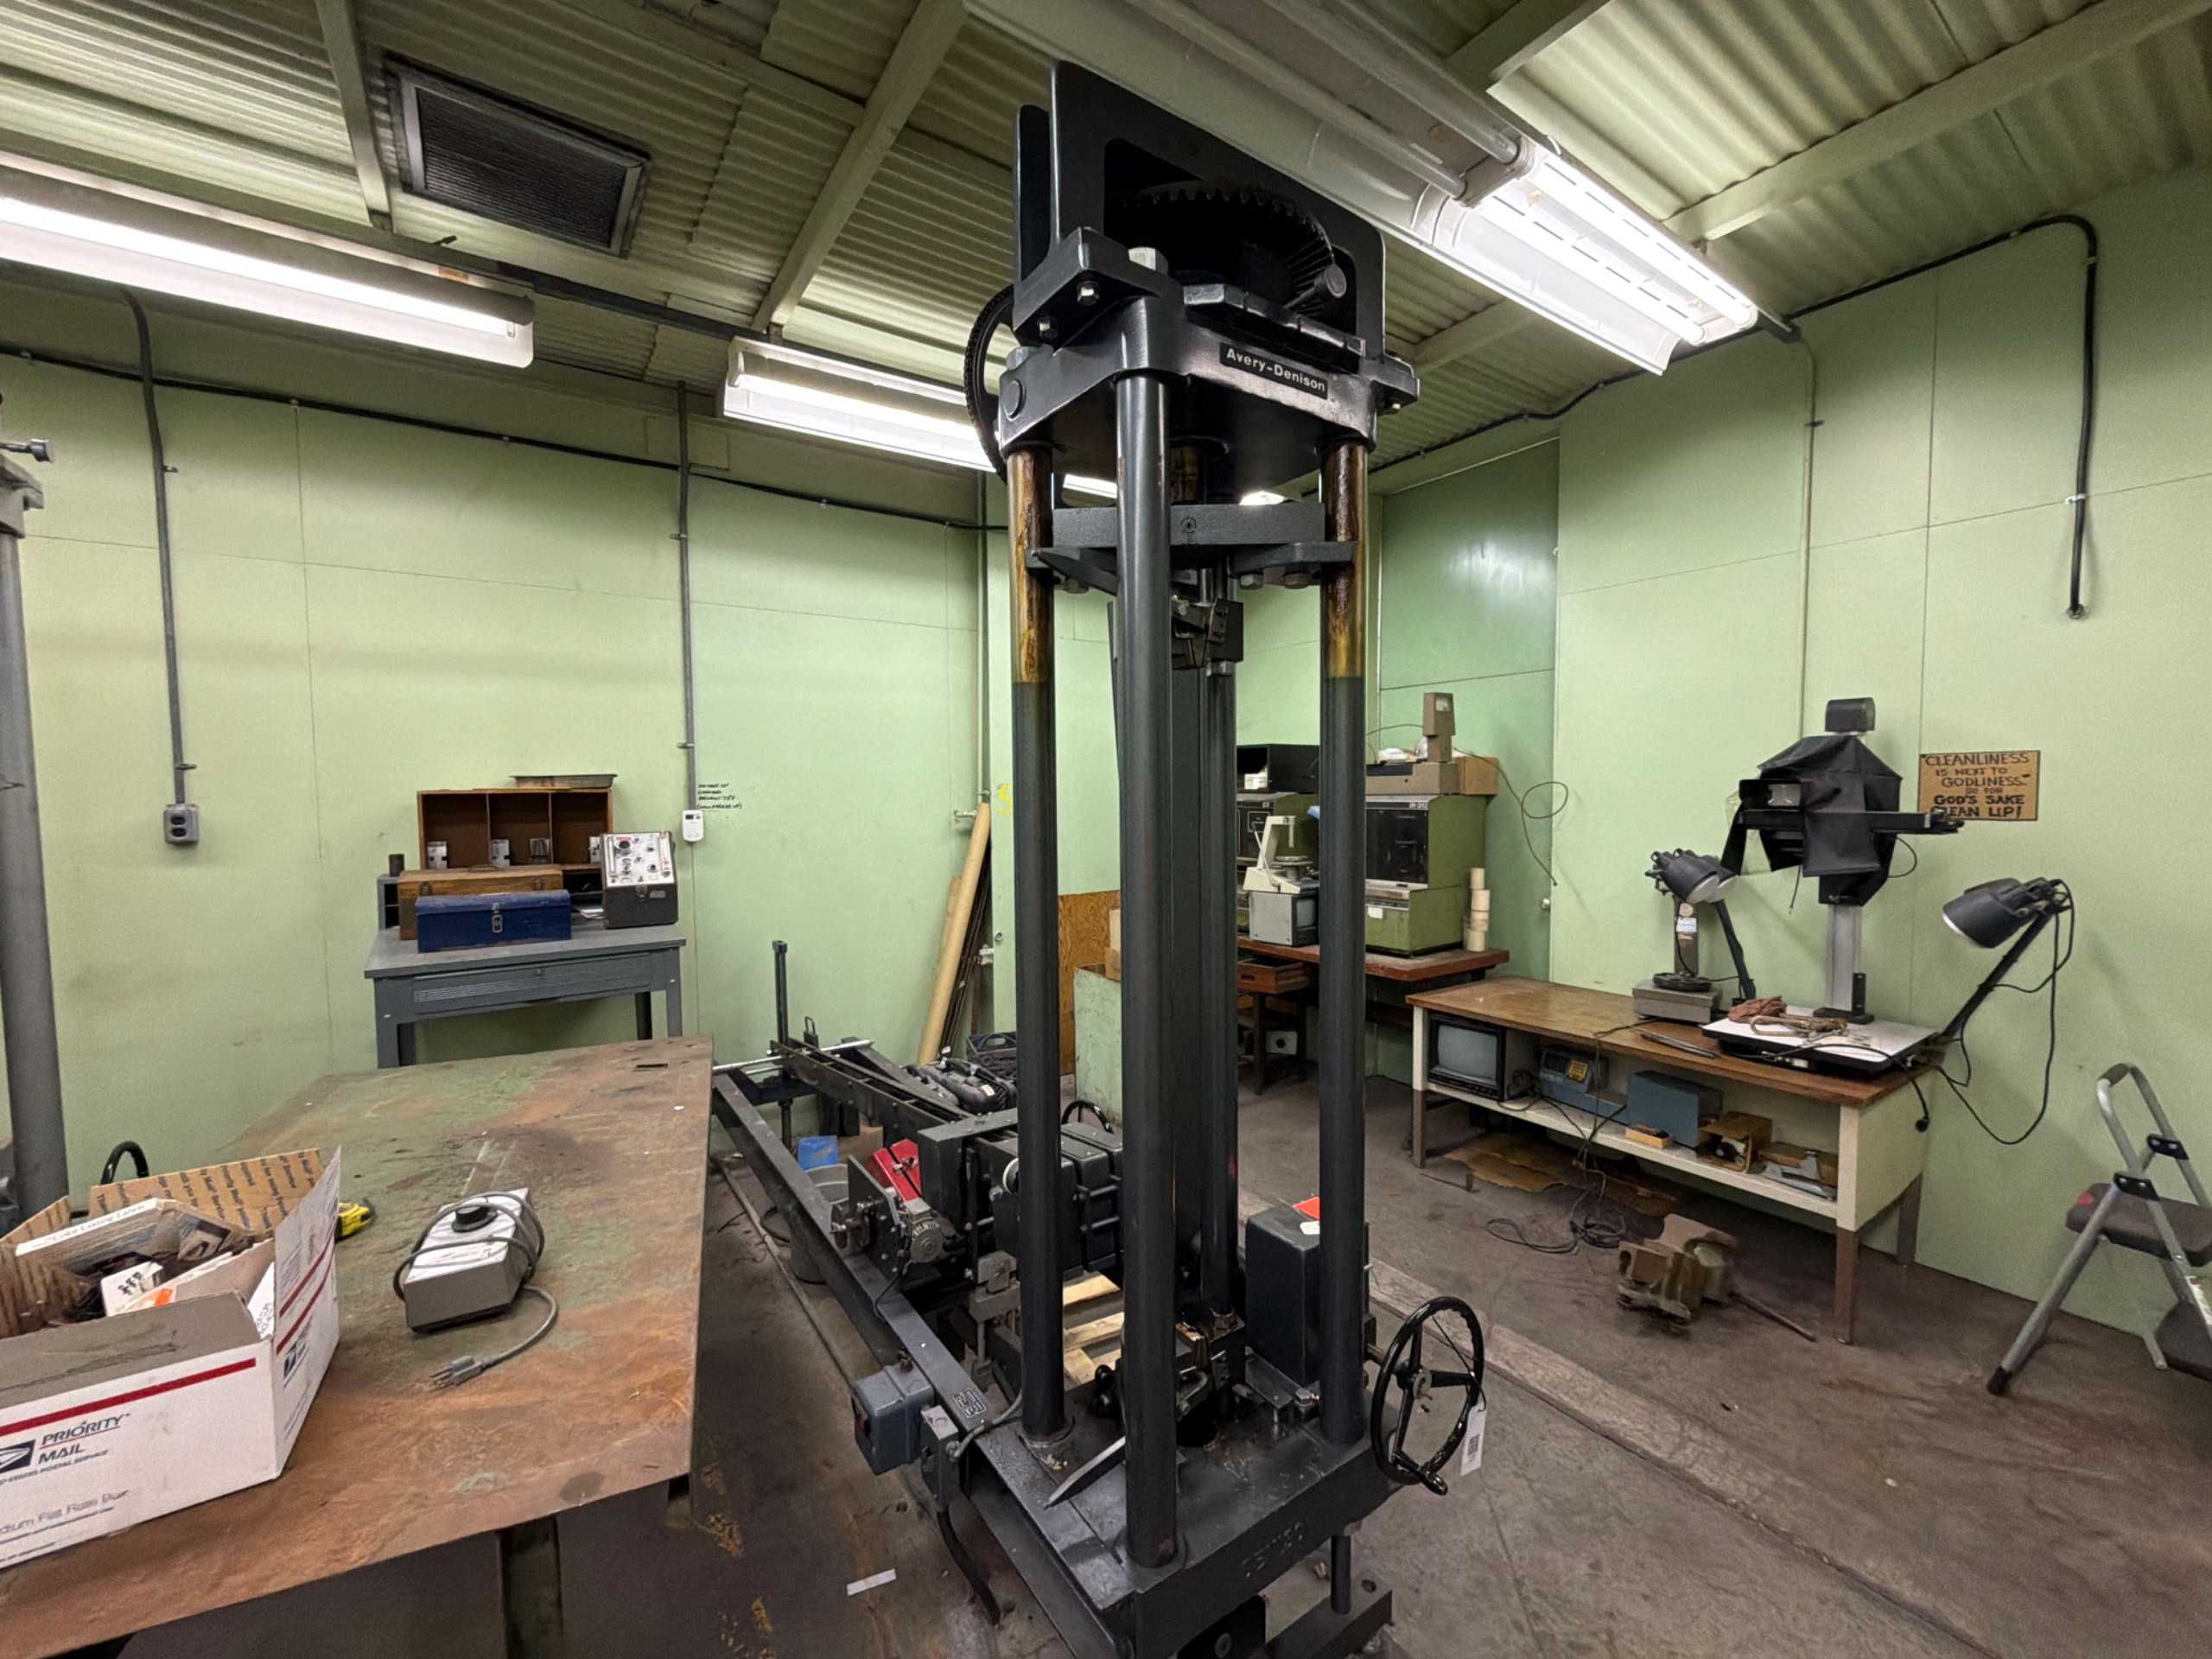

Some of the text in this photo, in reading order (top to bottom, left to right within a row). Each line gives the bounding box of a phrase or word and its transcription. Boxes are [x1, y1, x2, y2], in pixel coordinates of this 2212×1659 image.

[1226, 348, 1325, 392] Avery-Denison
[1925, 753, 2030, 766] CLEANLINESS
[1955, 767, 1985, 776] NEXT
[1990, 766, 2008, 775] TO
[1934, 794, 2025, 805] GOD'S SAKE
[1988, 805, 2023, 817] UP!
[38, 1443, 85, 1465] MAIL
